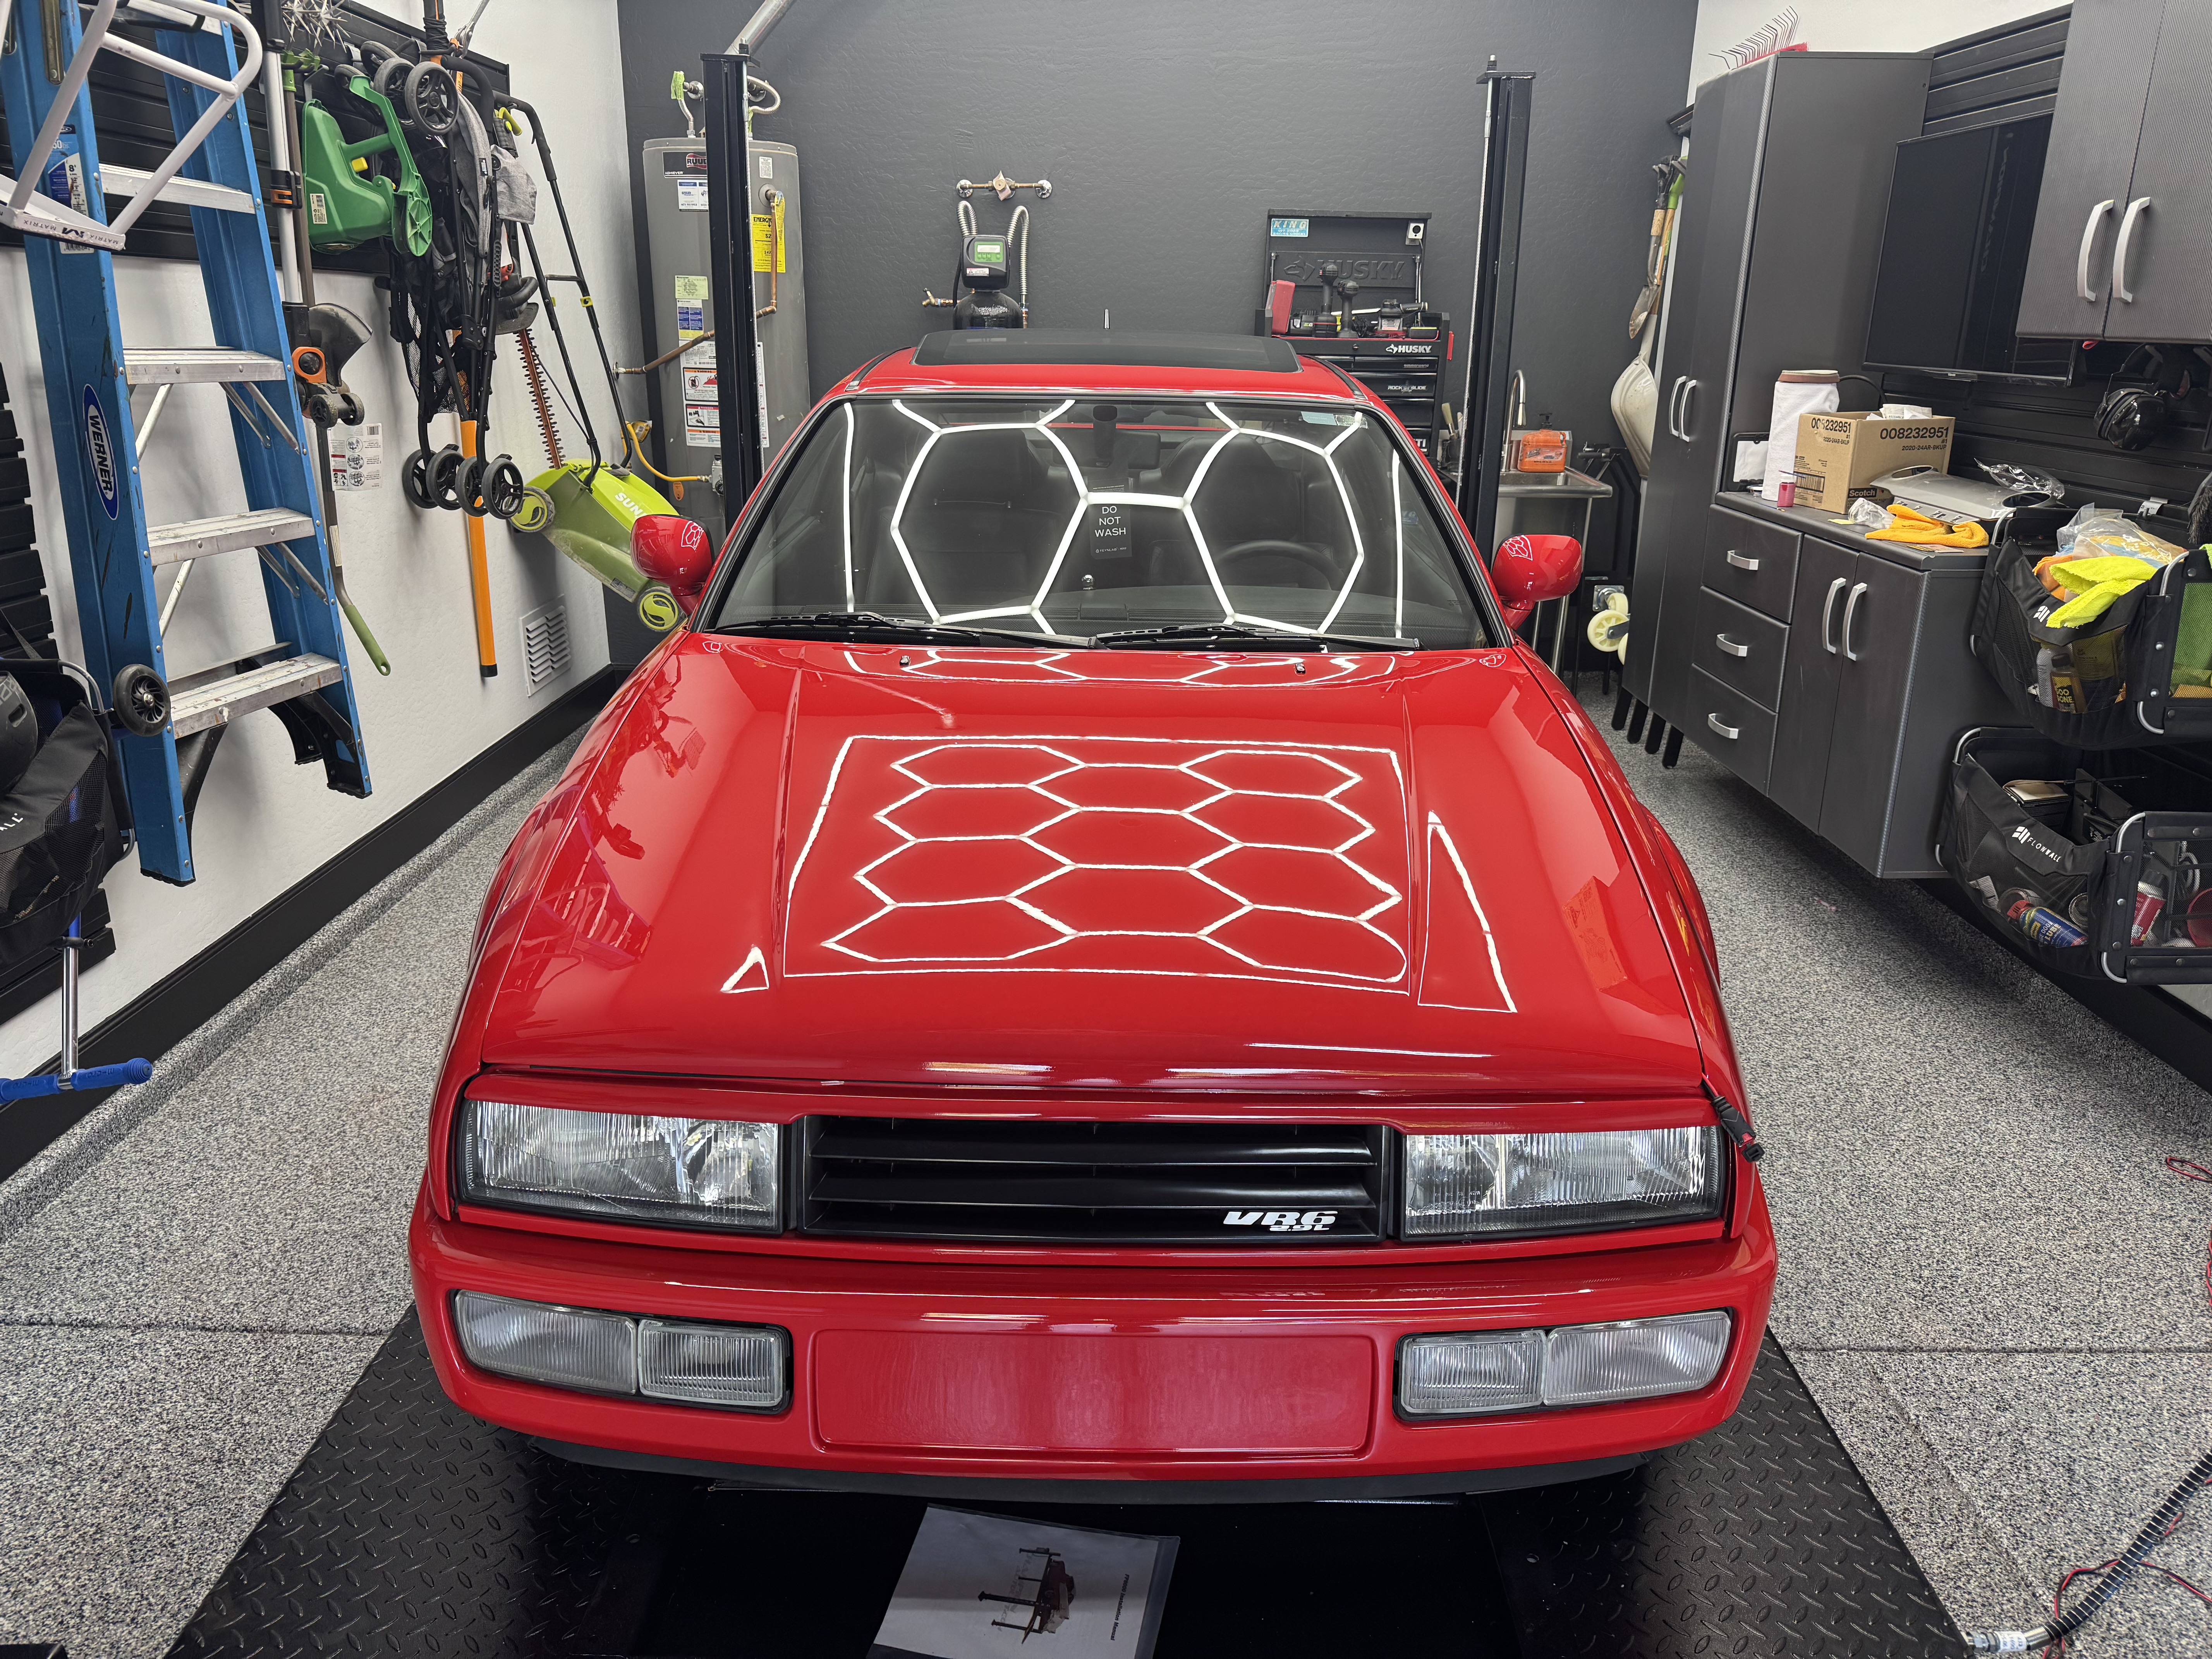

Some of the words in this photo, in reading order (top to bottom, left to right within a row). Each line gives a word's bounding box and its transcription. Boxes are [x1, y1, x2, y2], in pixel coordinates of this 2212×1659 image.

[24, 219, 57, 231] MATRIX
[1273, 220, 1307, 229] KING
[89, 234, 118, 244] MATRIX
[1398, 345, 1432, 353] HUSKY
[1880, 426, 1949, 440] 008232951
[89, 415, 113, 493] WERNER
[1102, 506, 1117, 514] DO
[1099, 516, 1121, 526] NOT
[1095, 527, 1127, 538] WASH
[2027, 837, 2062, 862] FLOWWALL
[1223, 1211, 1338, 1225] VR6
[1115, 1592, 1125, 1621] Installation
[1110, 1621, 1119, 1641] Manual
